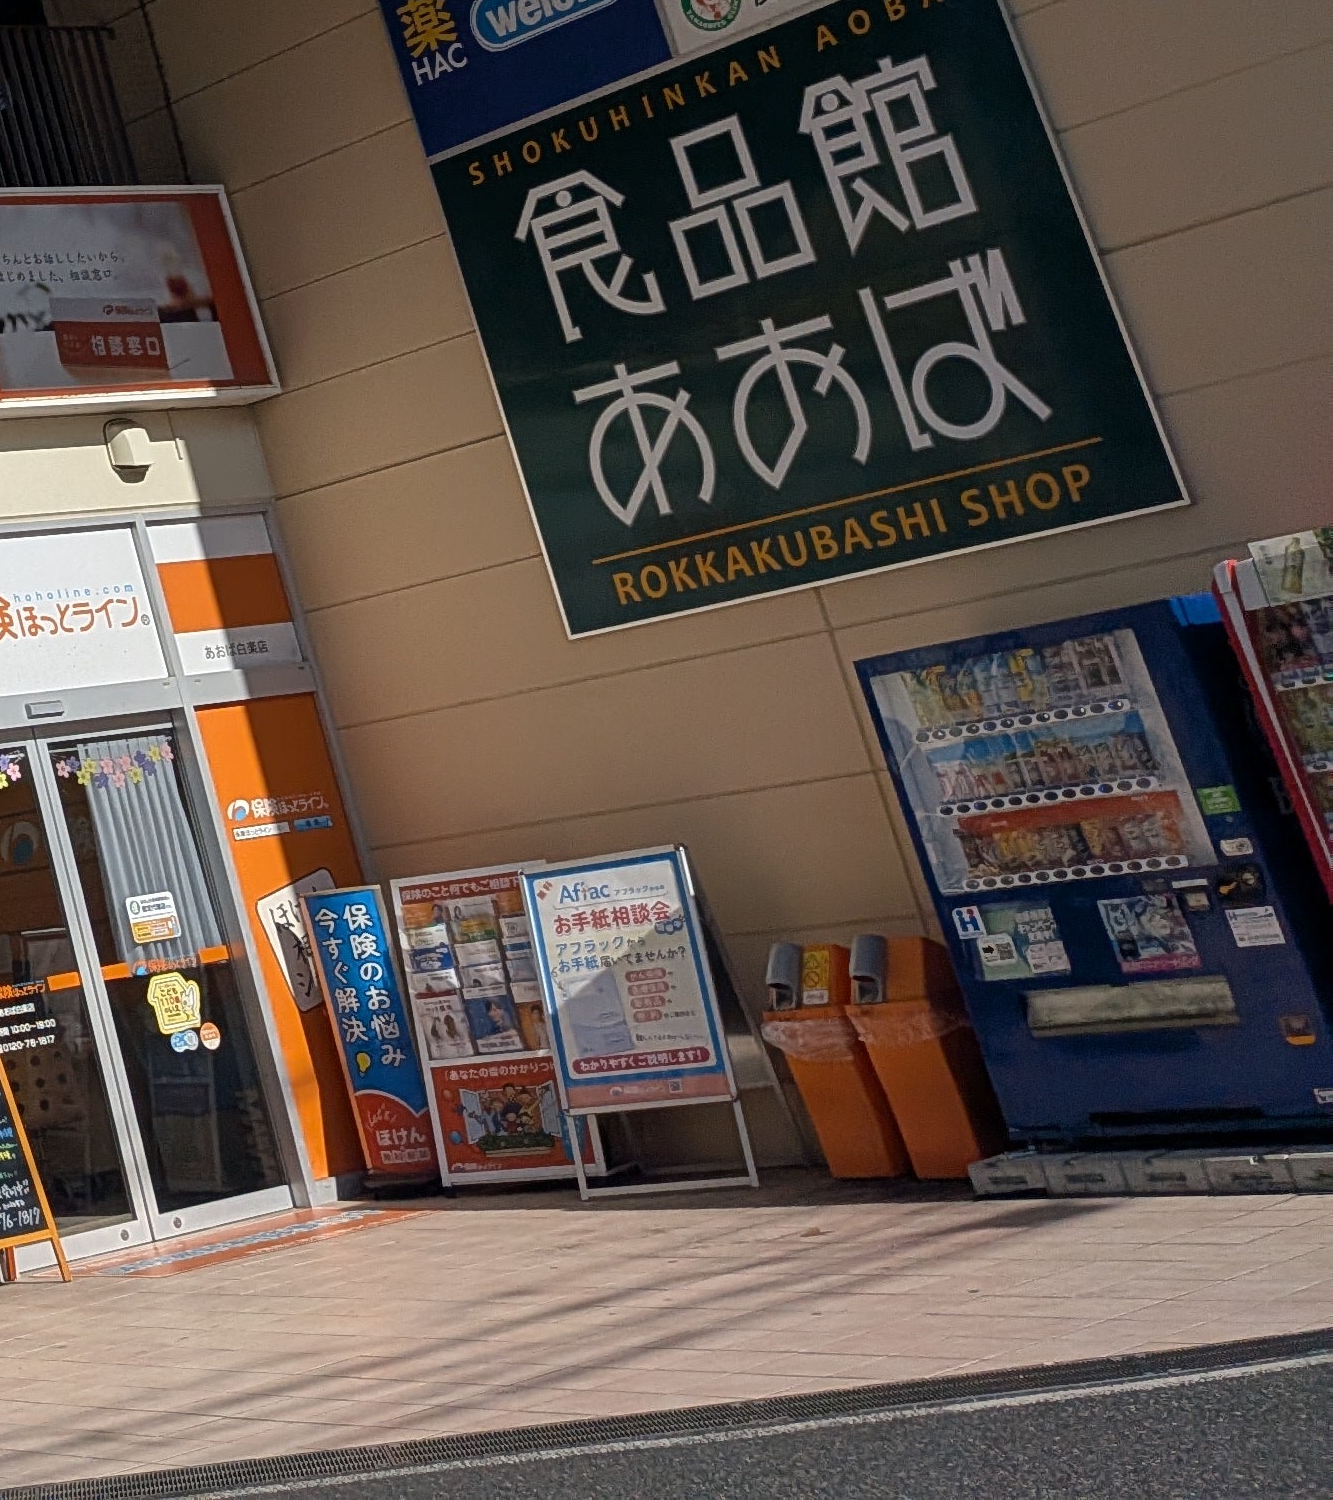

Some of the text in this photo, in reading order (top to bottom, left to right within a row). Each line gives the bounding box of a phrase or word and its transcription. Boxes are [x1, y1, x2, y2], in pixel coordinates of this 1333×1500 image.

[411, 42, 468, 86] HAC
[468, 46, 780, 186] SHOKUHINKAN
[514, 55, 981, 345] 食品館
[91, 335, 162, 357] 相談窓口
[573, 247, 1051, 528] あおば
[613, 463, 1093, 606] ROKKAKUBASHI SHOP
[13, 583, 134, 602] hoholine.com
[553, 900, 671, 935] お手紙相談会
[559, 882, 611, 904] Aflac
[313, 907, 369, 1043] 今すぐ解決
[341, 903, 406, 1067] 保険のお悩み
[375, 1127, 426, 1146] ほけん
